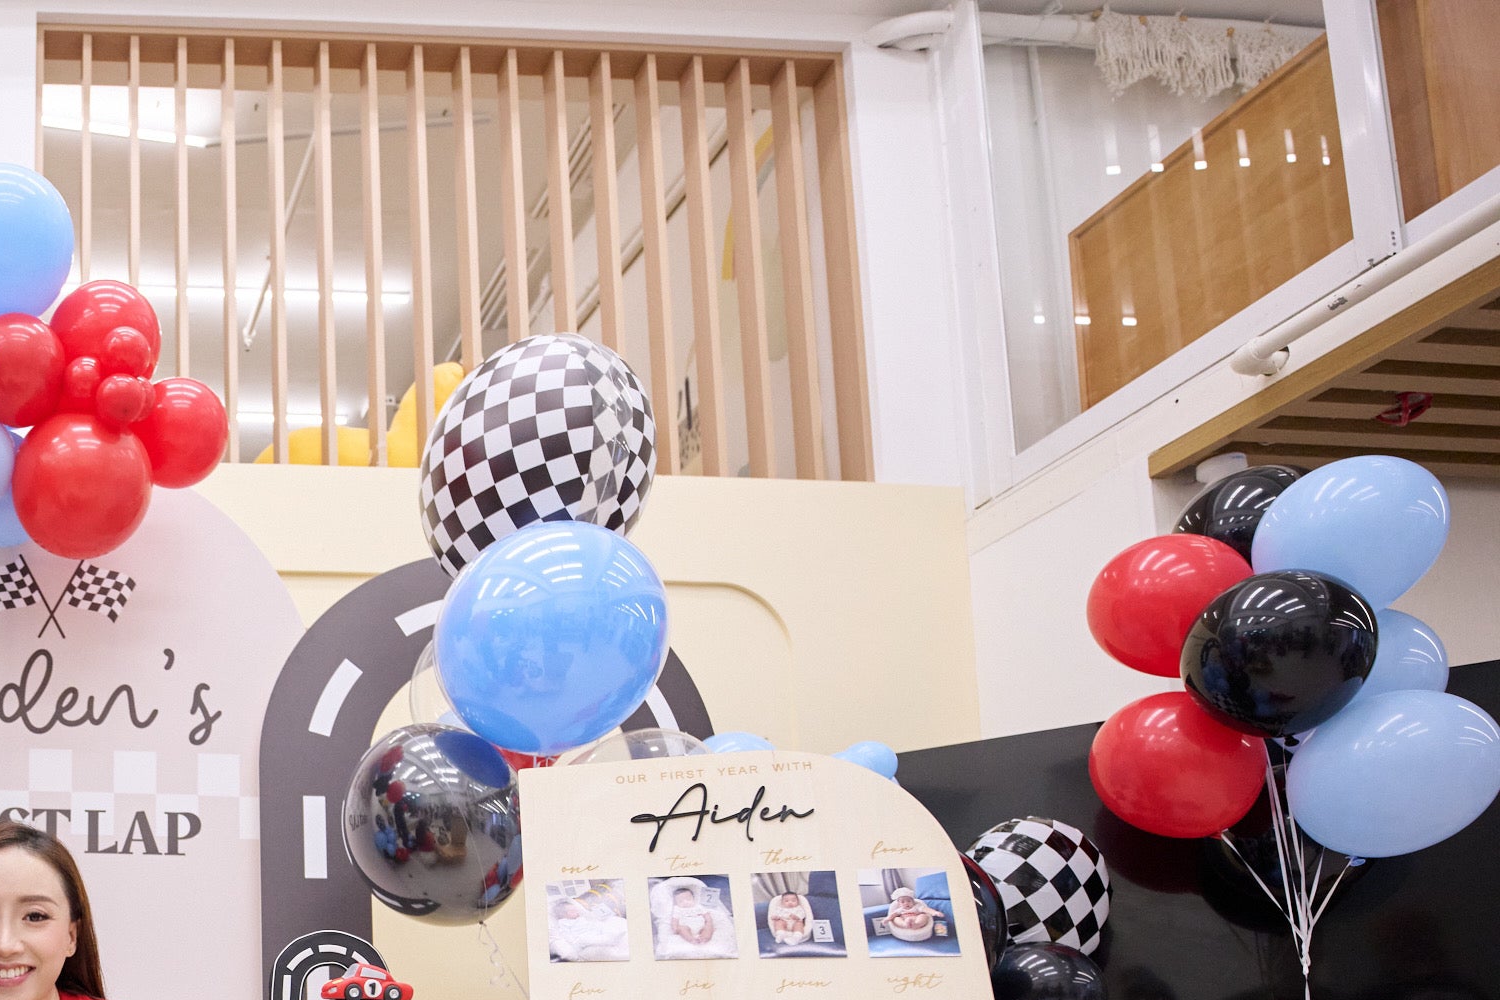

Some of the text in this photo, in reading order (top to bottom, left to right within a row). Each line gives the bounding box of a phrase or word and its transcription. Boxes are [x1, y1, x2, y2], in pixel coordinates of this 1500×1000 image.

[615, 761, 813, 784] OUR FIRST YEAR WITH
[630, 782, 815, 853] Aiden
[84, 809, 202, 856] LAP
[760, 848, 813, 866] three
[871, 840, 916, 860] four
[561, 863, 600, 875] one
[665, 854, 704, 872] two
[368, 982, 377, 996] 1
[569, 982, 608, 1000] five
[679, 978, 716, 996] six
[776, 977, 832, 994] seven
[886, 973, 943, 994] eight
